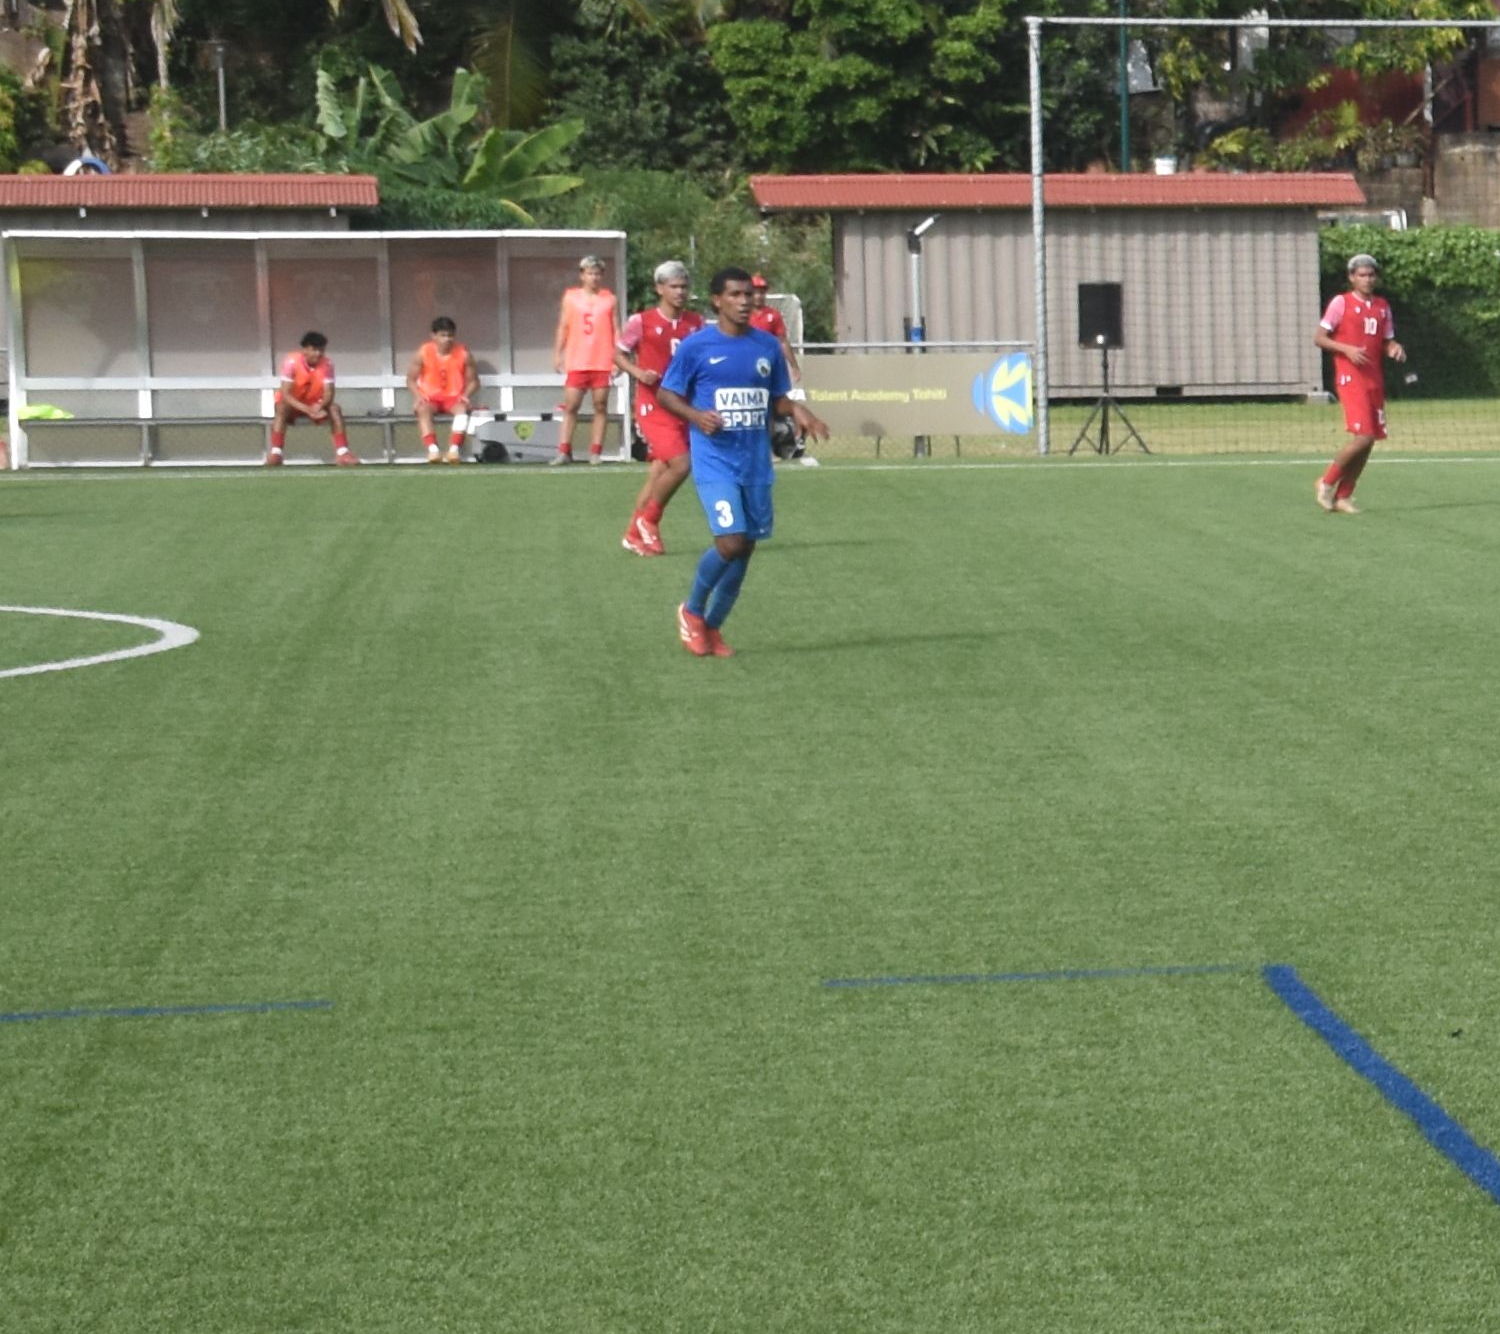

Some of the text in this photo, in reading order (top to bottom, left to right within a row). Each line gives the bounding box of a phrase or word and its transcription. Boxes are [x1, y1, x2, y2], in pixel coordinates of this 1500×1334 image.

[583, 313, 594, 335] 5
[1364, 316, 1378, 336] 10
[719, 391, 765, 407] VAIMA
[809, 389, 848, 402] Talent
[721, 411, 766, 428] SPORT
[715, 500, 735, 528] 3
